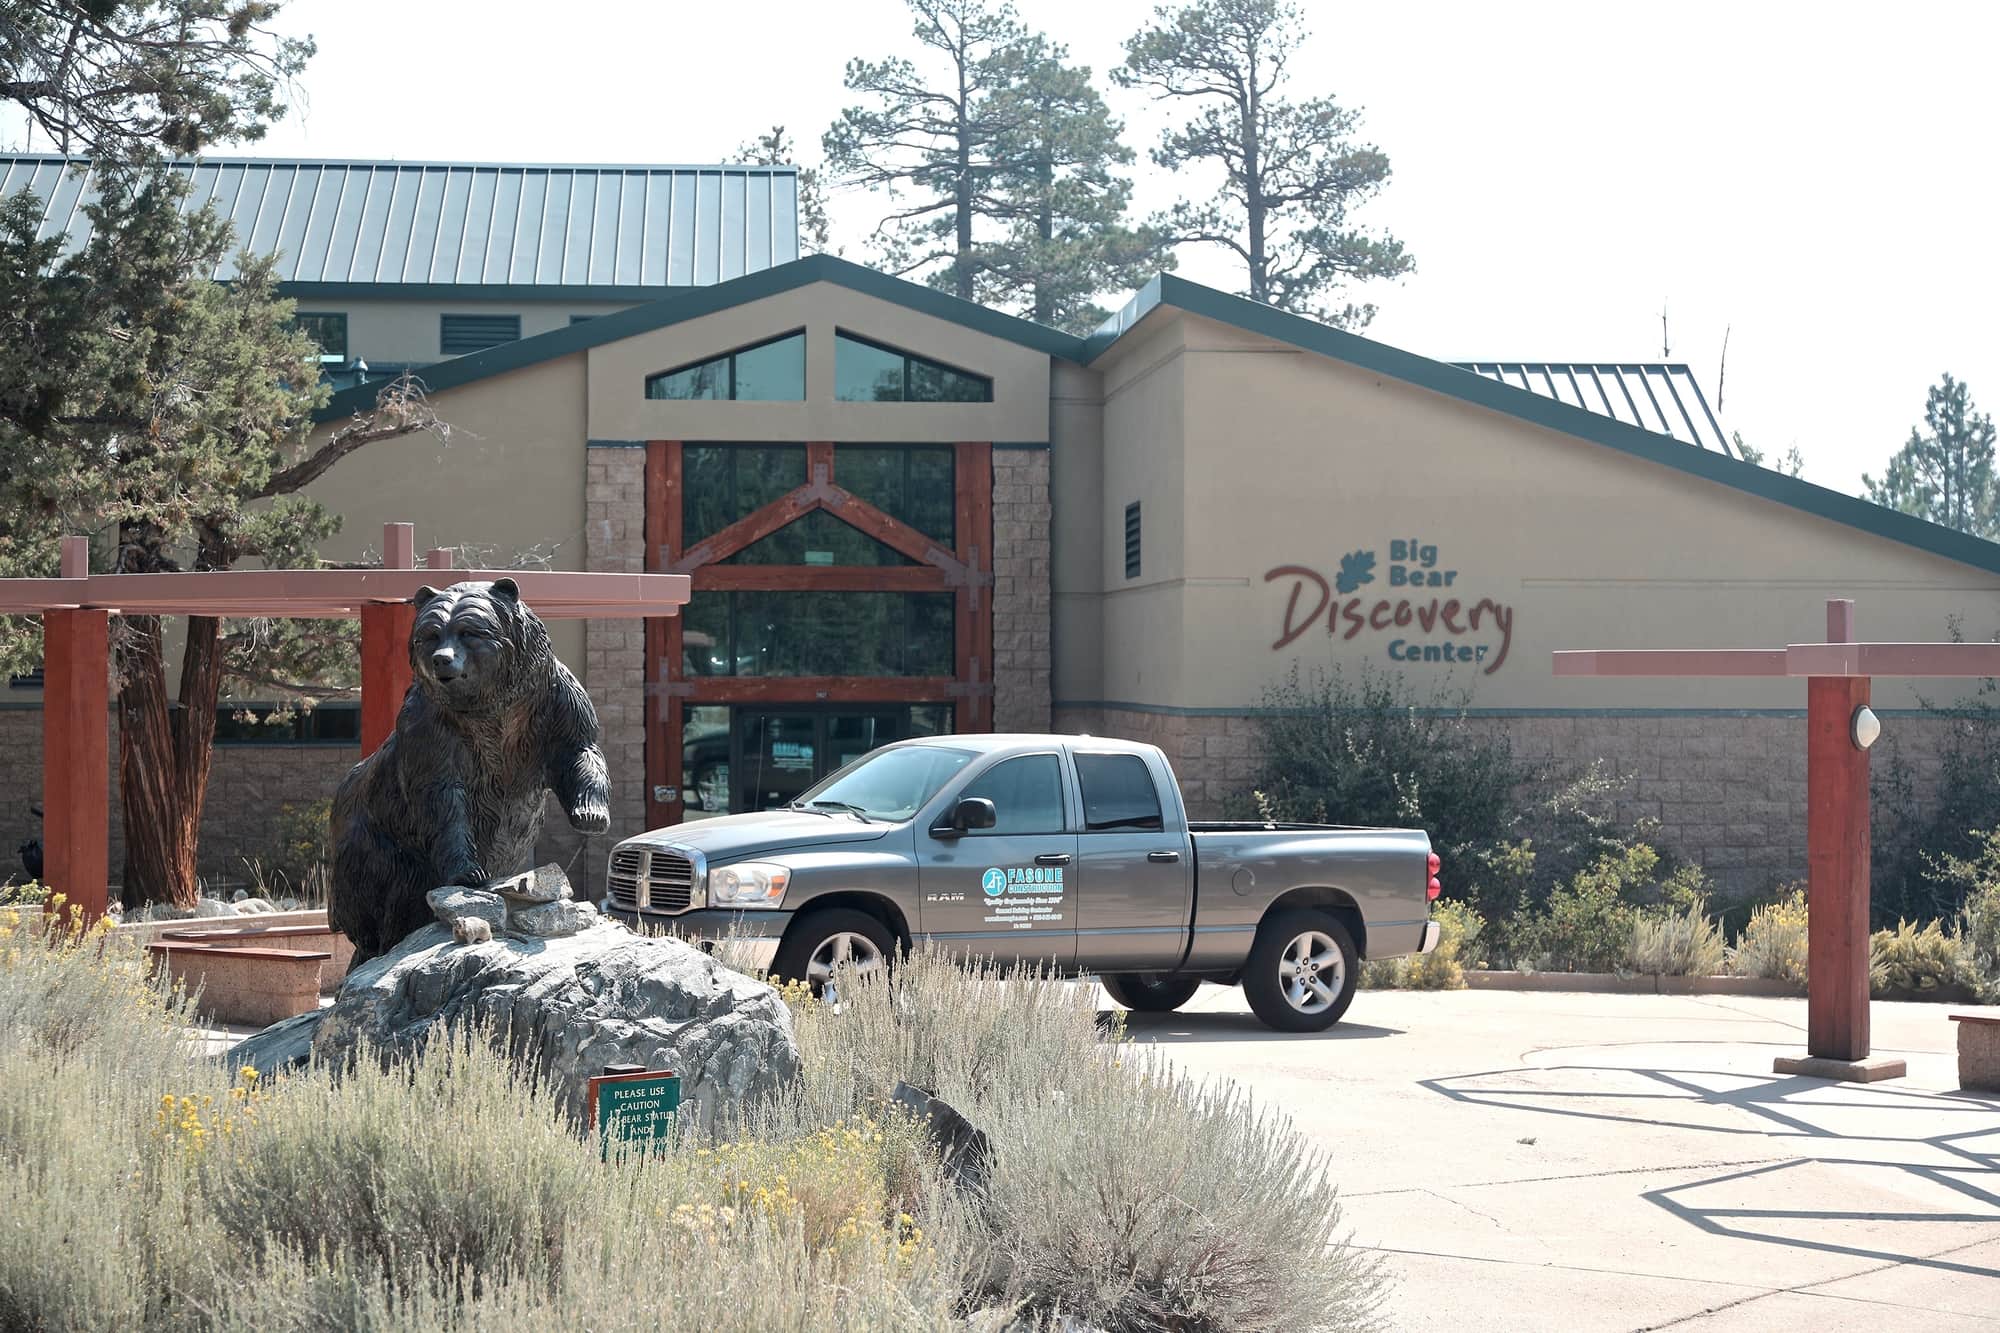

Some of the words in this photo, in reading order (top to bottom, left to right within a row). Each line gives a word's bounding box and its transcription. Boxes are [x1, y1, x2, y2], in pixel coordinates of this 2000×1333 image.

[1390, 539, 1438, 567] Big
[1390, 565, 1457, 587] Bear
[1264, 565, 1512, 675] Discovery
[1388, 639, 1488, 663] Center
[1008, 868, 1063, 883] FASONE
[1008, 883, 1063, 894] CONSTRUCTION
[927, 893, 965, 901] RAM
[614, 1088, 646, 1099] PLEASE
[650, 1086, 665, 1096] USE
[620, 1100, 660, 1111] CAUTION
[622, 1115, 642, 1124] BEAR
[645, 1111, 675, 1122] STATU
[631, 1126, 650, 1135] AND
